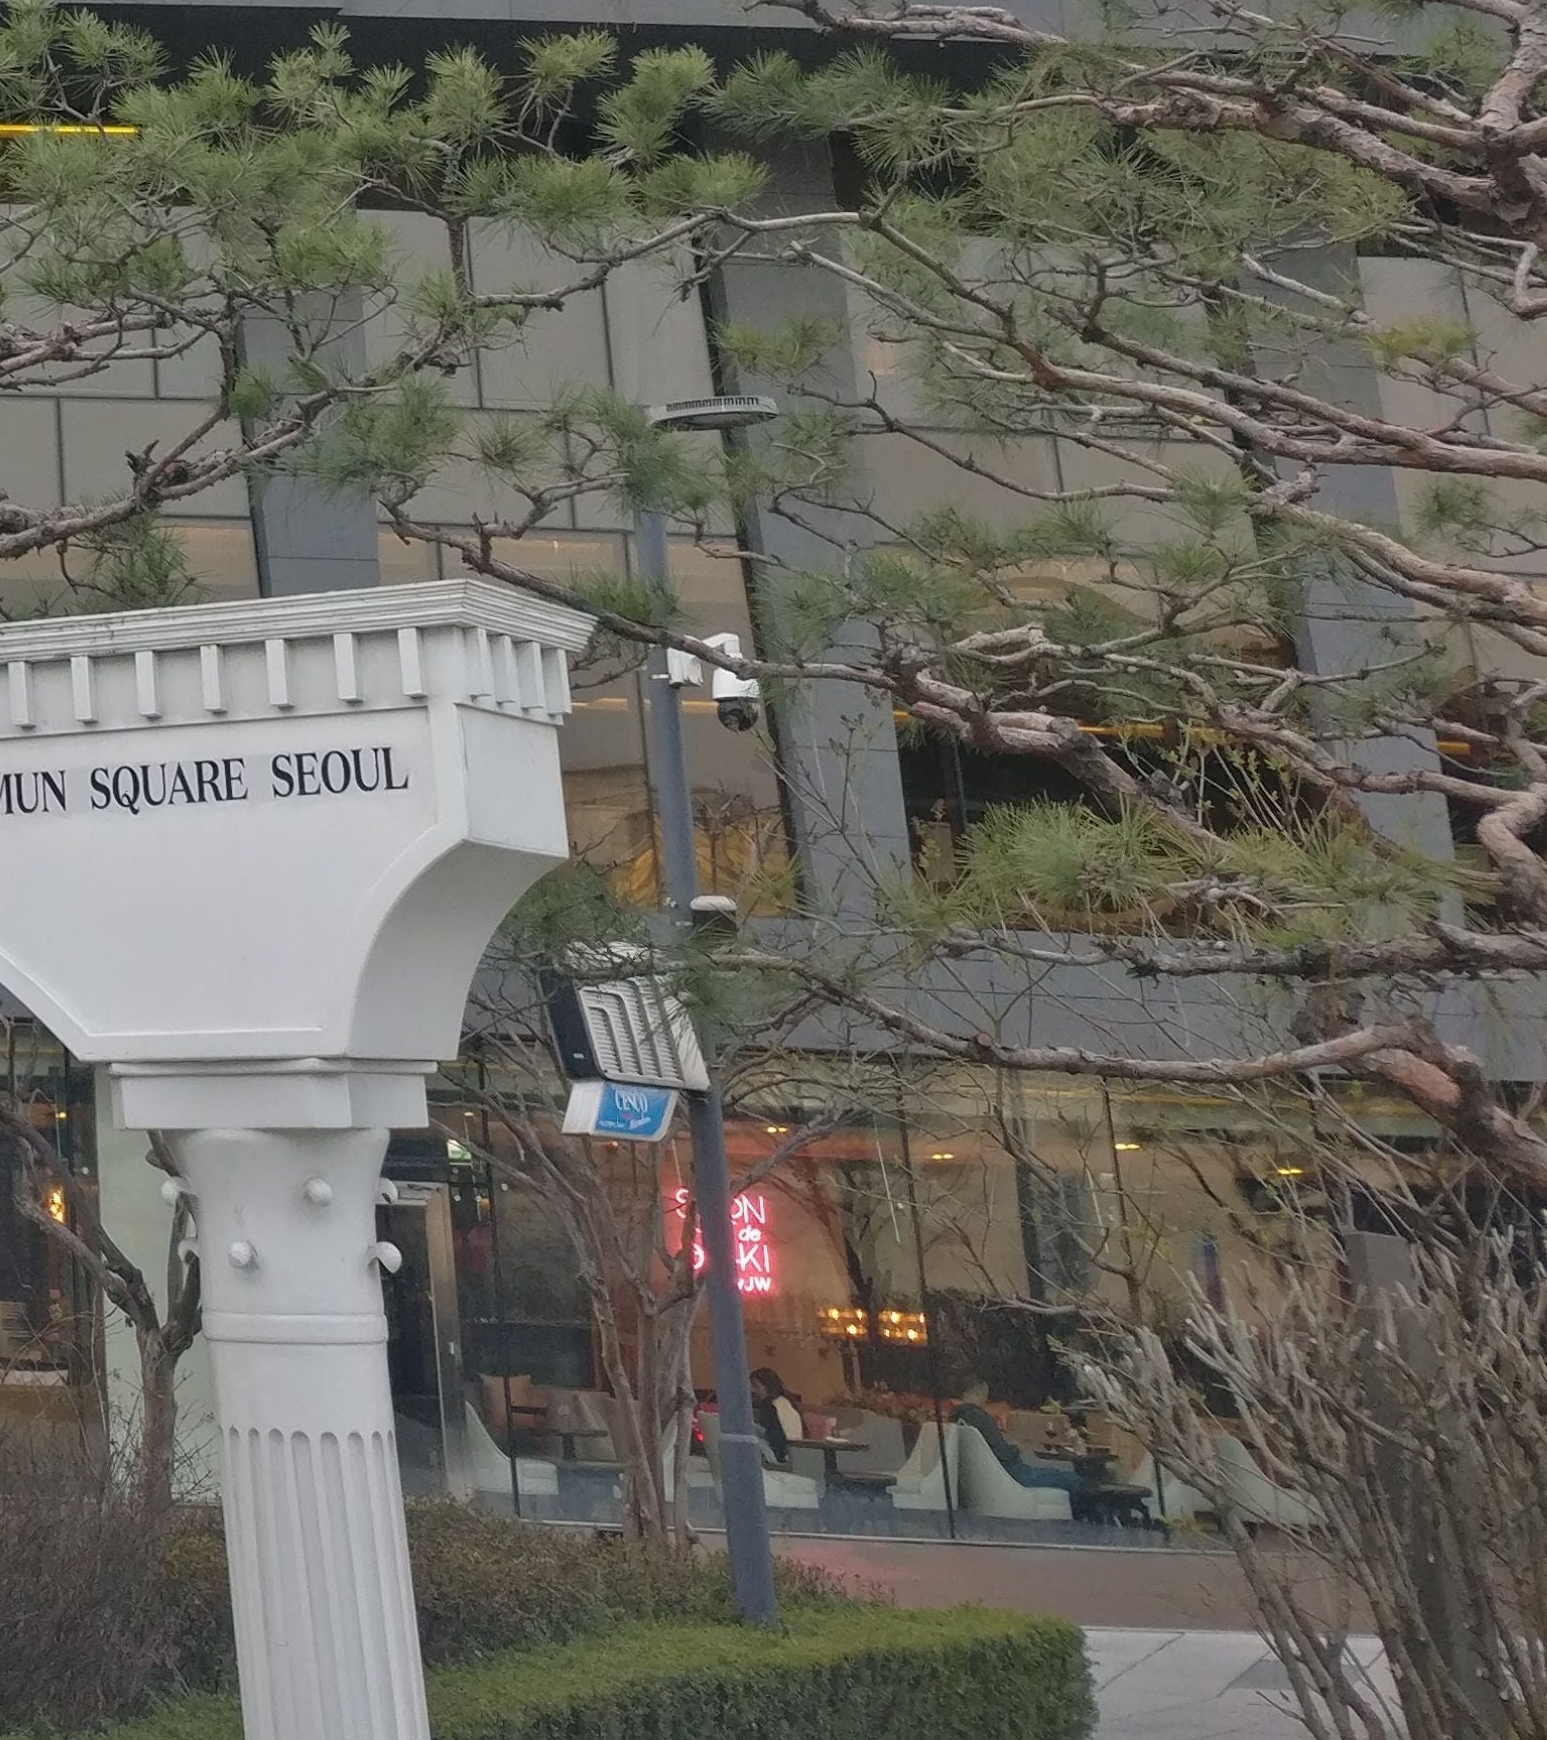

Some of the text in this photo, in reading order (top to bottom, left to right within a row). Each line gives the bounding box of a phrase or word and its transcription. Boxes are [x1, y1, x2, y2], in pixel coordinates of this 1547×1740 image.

[90, 758, 248, 816] SQUARE
[271, 746, 409, 798] SEOUL
[738, 1224, 762, 1242] de
